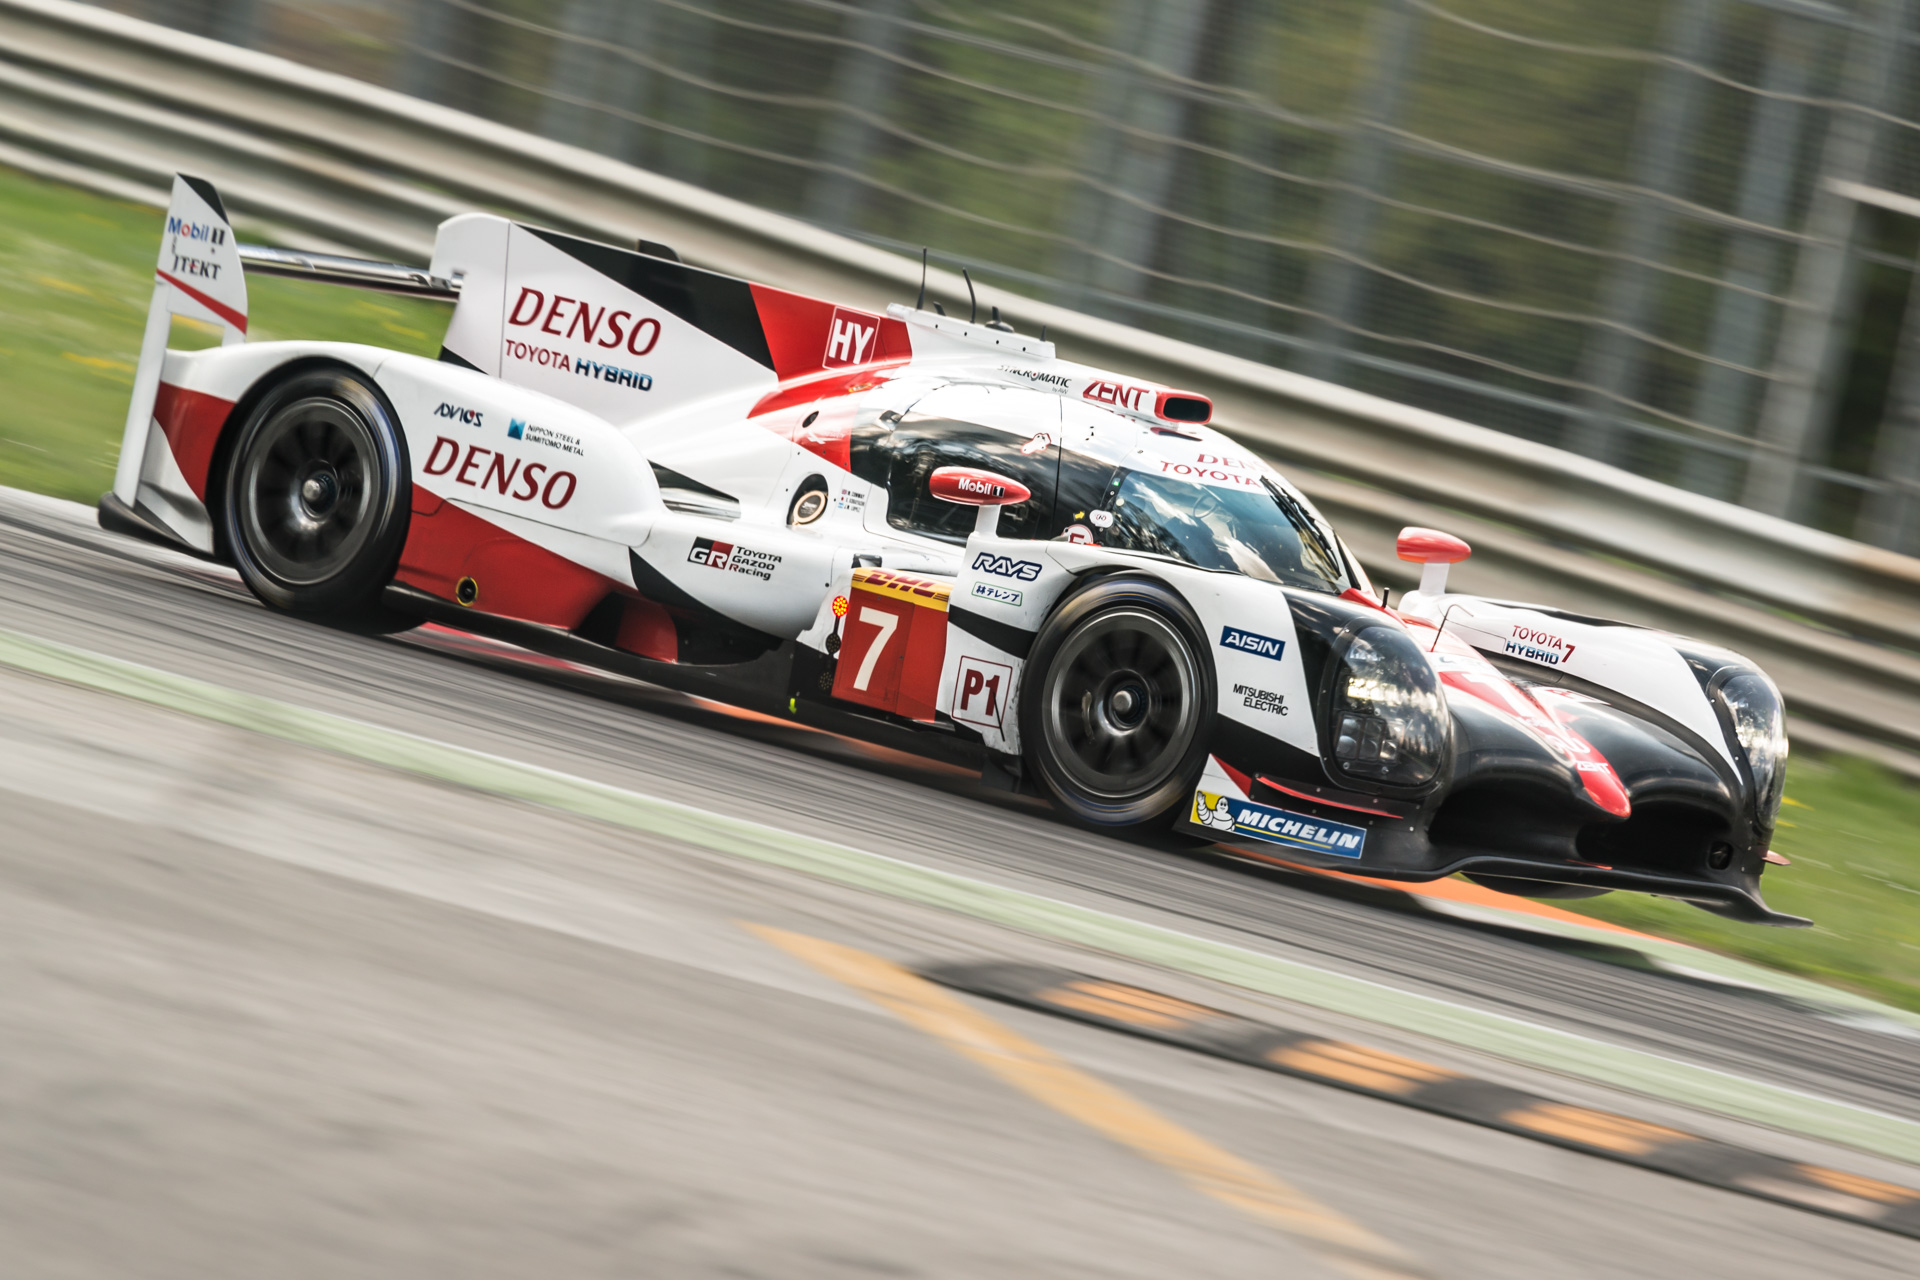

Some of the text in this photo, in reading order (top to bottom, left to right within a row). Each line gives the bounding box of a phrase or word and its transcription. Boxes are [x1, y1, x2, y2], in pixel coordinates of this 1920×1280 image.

[168, 216, 209, 243] Mobil
[171, 254, 221, 280] JTEKT
[508, 286, 661, 356] DENSO
[828, 318, 874, 365] HY
[505, 338, 653, 391] TOYOTA HYBRID
[1083, 378, 1149, 411] ZENT
[433, 402, 483, 427] ADVICS
[525, 433, 584, 456] SUMITOMO METAL
[527, 424, 554, 437] NIPPON
[555, 432, 574, 444] STEEL
[422, 435, 577, 509] DENSO
[1160, 460, 1262, 488] TOYOTA
[958, 478, 993, 495] Mobil
[689, 546, 728, 570] GR
[732, 555, 775, 571] GAZOO
[736, 546, 782, 563] TOYOTA
[972, 552, 1042, 582] RAYS
[729, 563, 771, 581] Racing
[864, 569, 937, 598] DHL
[975, 585, 1020, 603] 林テレンプ
[853, 606, 899, 691] 7
[1225, 631, 1280, 656] AISIN
[1505, 640, 1560, 665] HYBRID
[1512, 625, 1576, 663] TOYOTA 7
[960, 668, 1000, 717] P1
[1232, 683, 1285, 705] MITSUBISHI
[1243, 697, 1289, 716] ELECTRIC
[1237, 808, 1361, 849] MICHELIN
